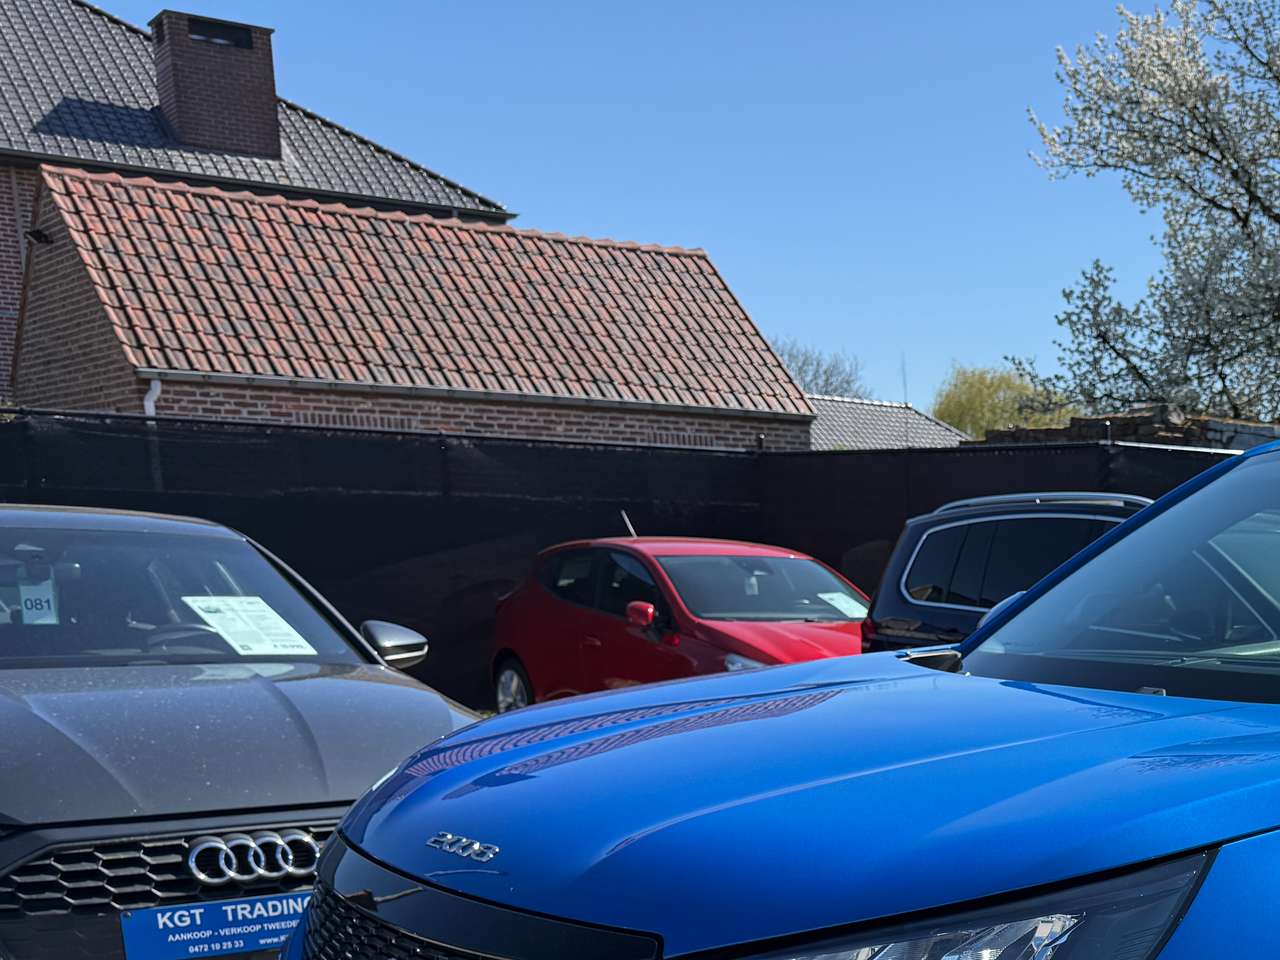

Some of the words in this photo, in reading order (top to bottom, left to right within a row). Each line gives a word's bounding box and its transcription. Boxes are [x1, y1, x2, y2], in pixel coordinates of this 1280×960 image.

[23, 598, 51, 611] 081
[426, 831, 499, 862] 2008
[157, 909, 204, 929] KGT
[167, 930, 213, 942] AANKOOP
[219, 925, 262, 936] VERKOOP
